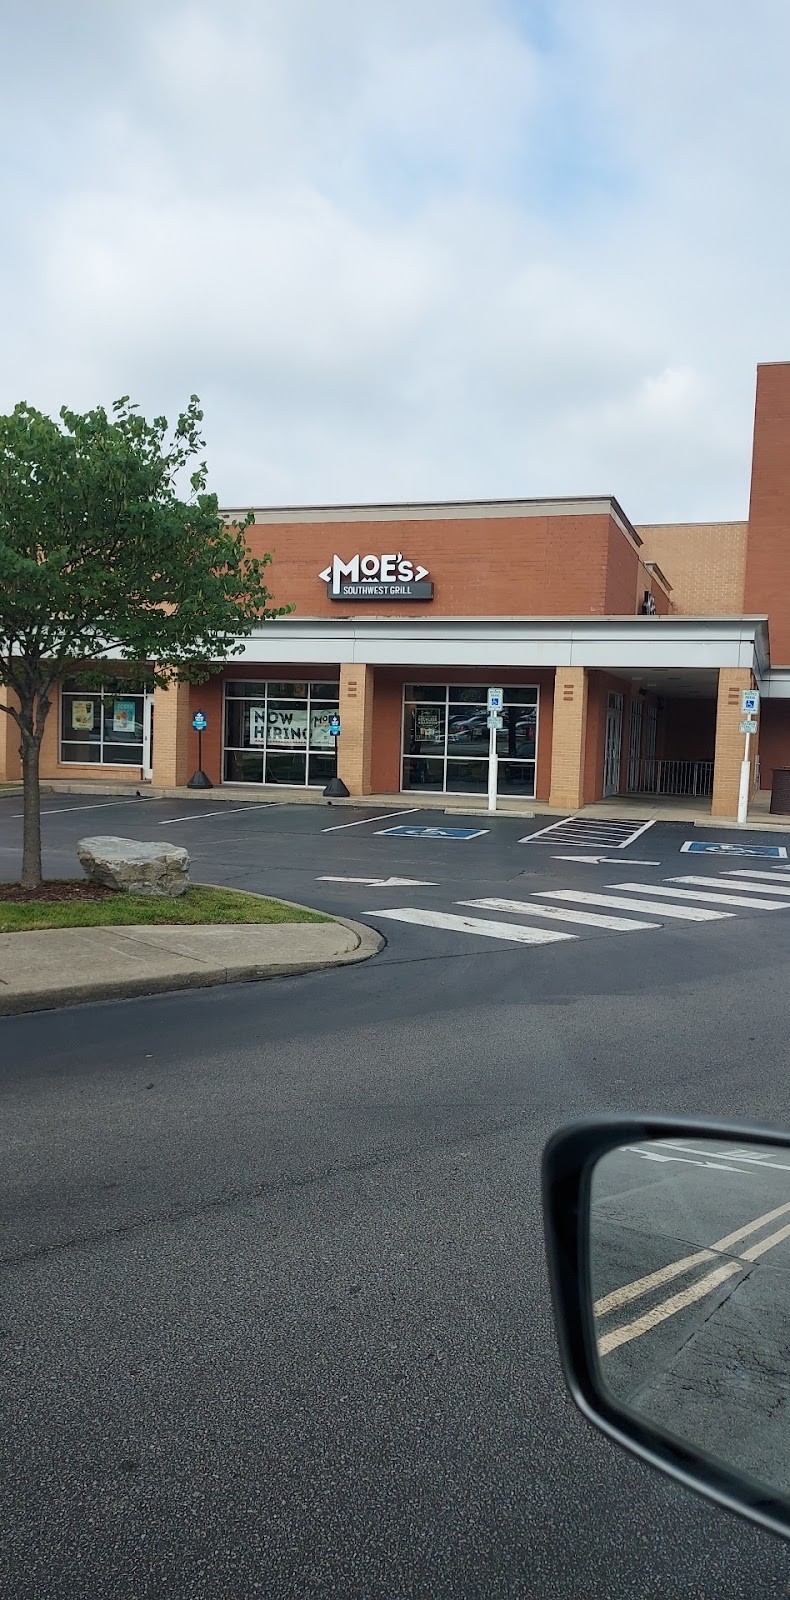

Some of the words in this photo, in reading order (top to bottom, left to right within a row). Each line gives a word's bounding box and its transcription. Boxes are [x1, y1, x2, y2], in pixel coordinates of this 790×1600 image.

[343, 586, 388, 595] SOUTHWEST
[389, 586, 412, 595] GRILL
[254, 710, 294, 725] NOW
[254, 726, 313, 740] HIRING
